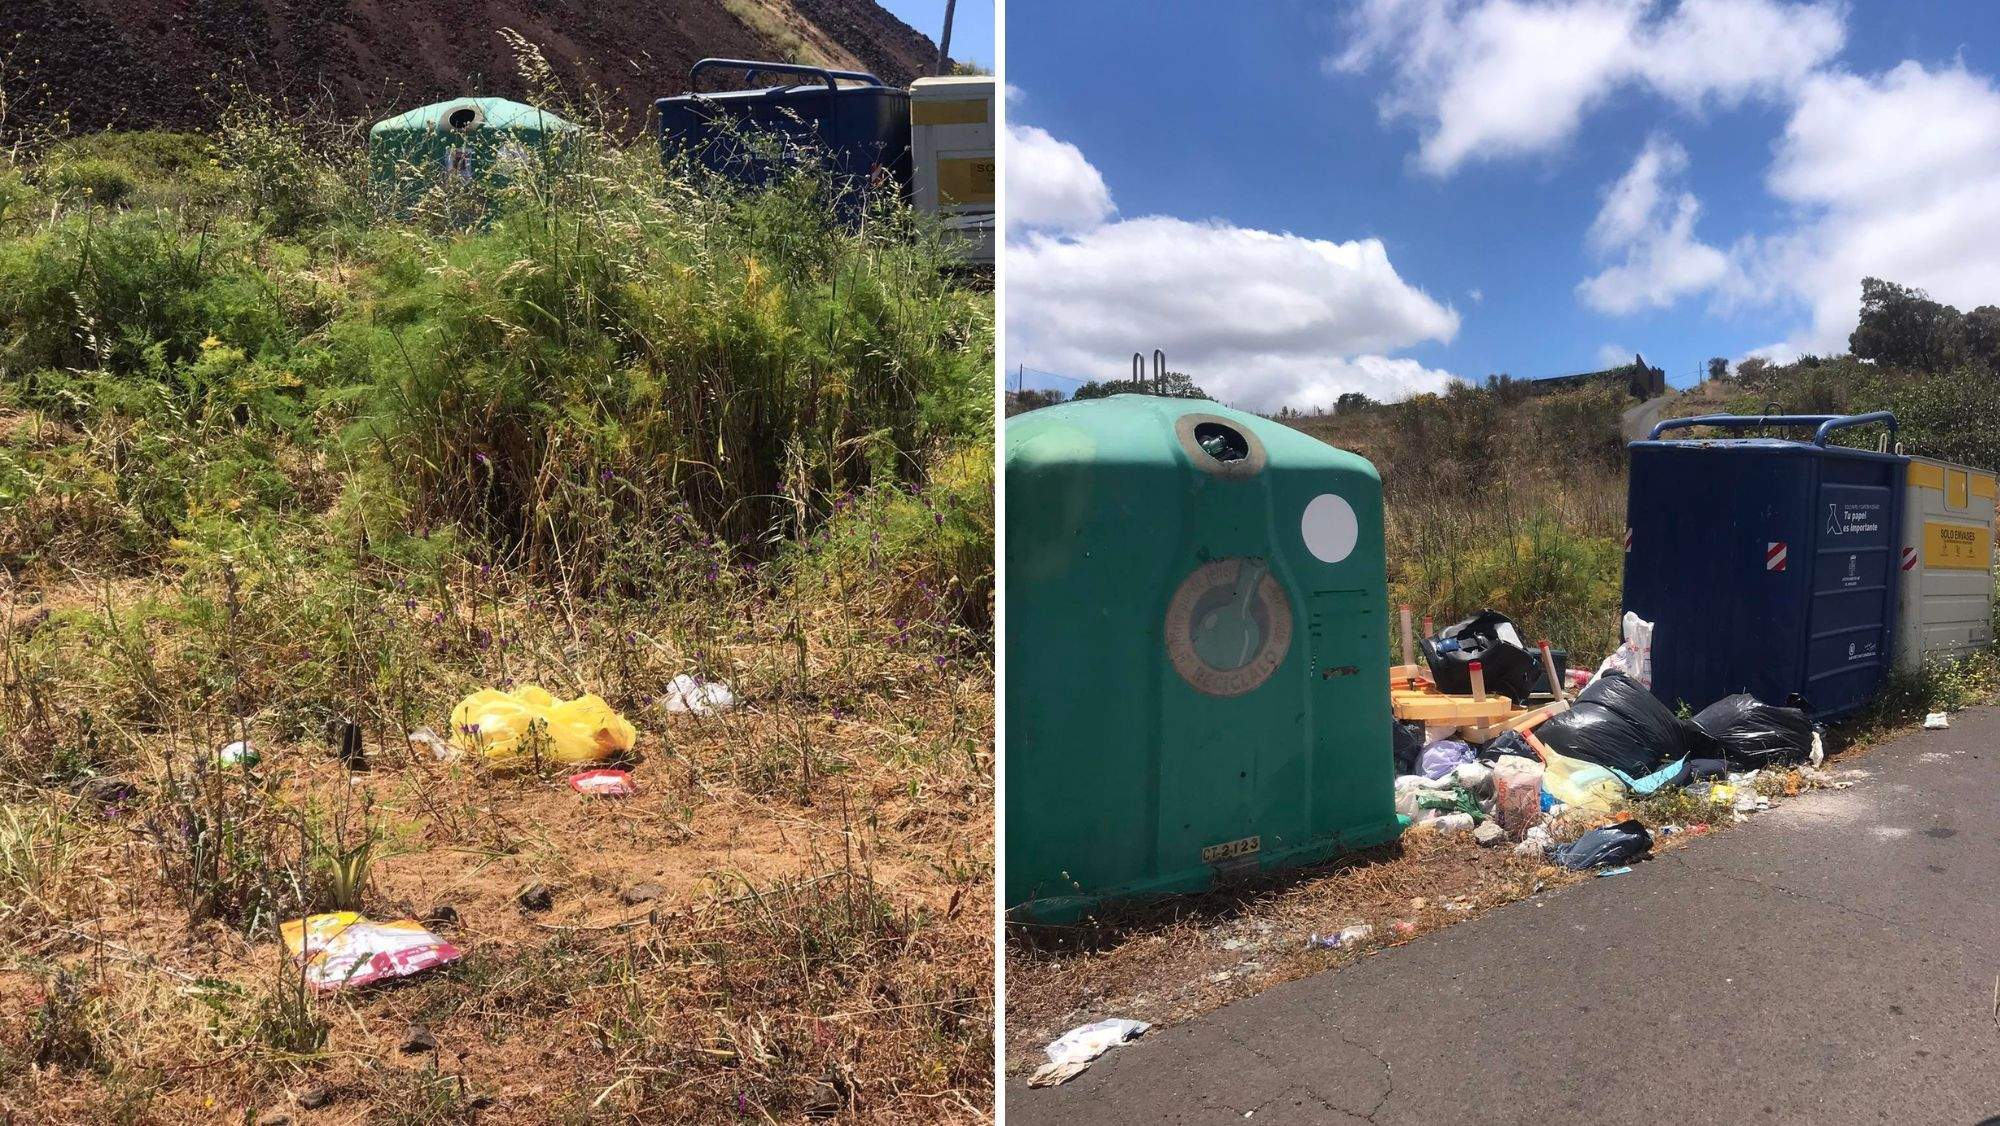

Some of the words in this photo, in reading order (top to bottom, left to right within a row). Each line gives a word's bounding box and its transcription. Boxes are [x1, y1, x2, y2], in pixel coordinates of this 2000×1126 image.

[1844, 511, 1851, 520] Tu
[1852, 511, 1867, 522] papel
[1850, 523, 1878, 534] importante
[1940, 528, 1954, 539] SOLO
[1954, 530, 1976, 541] ENVASES
